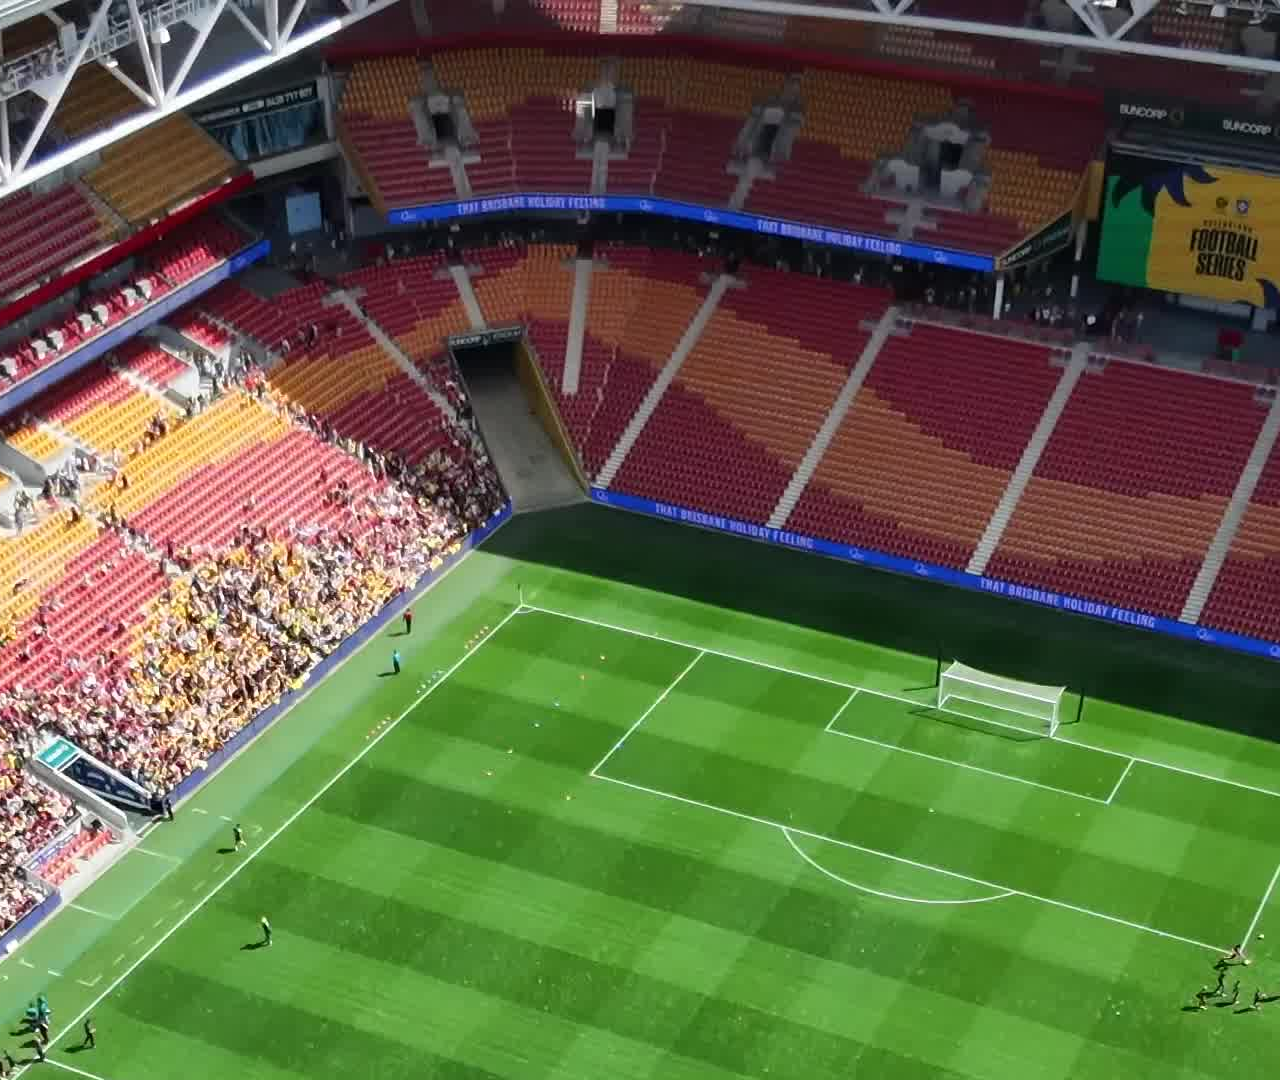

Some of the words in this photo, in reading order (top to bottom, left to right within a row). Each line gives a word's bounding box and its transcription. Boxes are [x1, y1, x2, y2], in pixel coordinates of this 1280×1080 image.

[1119, 103, 1168, 119] SUNCORP
[1222, 119, 1272, 136] SUNCORP
[458, 200, 478, 216] THAT
[528, 196, 565, 209] HOLIDAY
[569, 196, 605, 209] FEELING
[757, 218, 779, 234] THAT
[825, 231, 863, 249] HOLIDAY
[865, 238, 902, 255] FEELING
[1190, 228, 1258, 262] FOOTBALL
[1195, 252, 1246, 282] SERIES
[655, 503, 679, 519] THAT
[681, 508, 726, 530] BRISBANE
[729, 519, 771, 540] HOLIDAY
[773, 528, 815, 550] FEELING
[980, 578, 1006, 593] THAT
[1008, 583, 1061, 607] BRISBANE
[1063, 597, 1109, 618] HOLIDAY
[1111, 606, 1156, 629] FEELING
